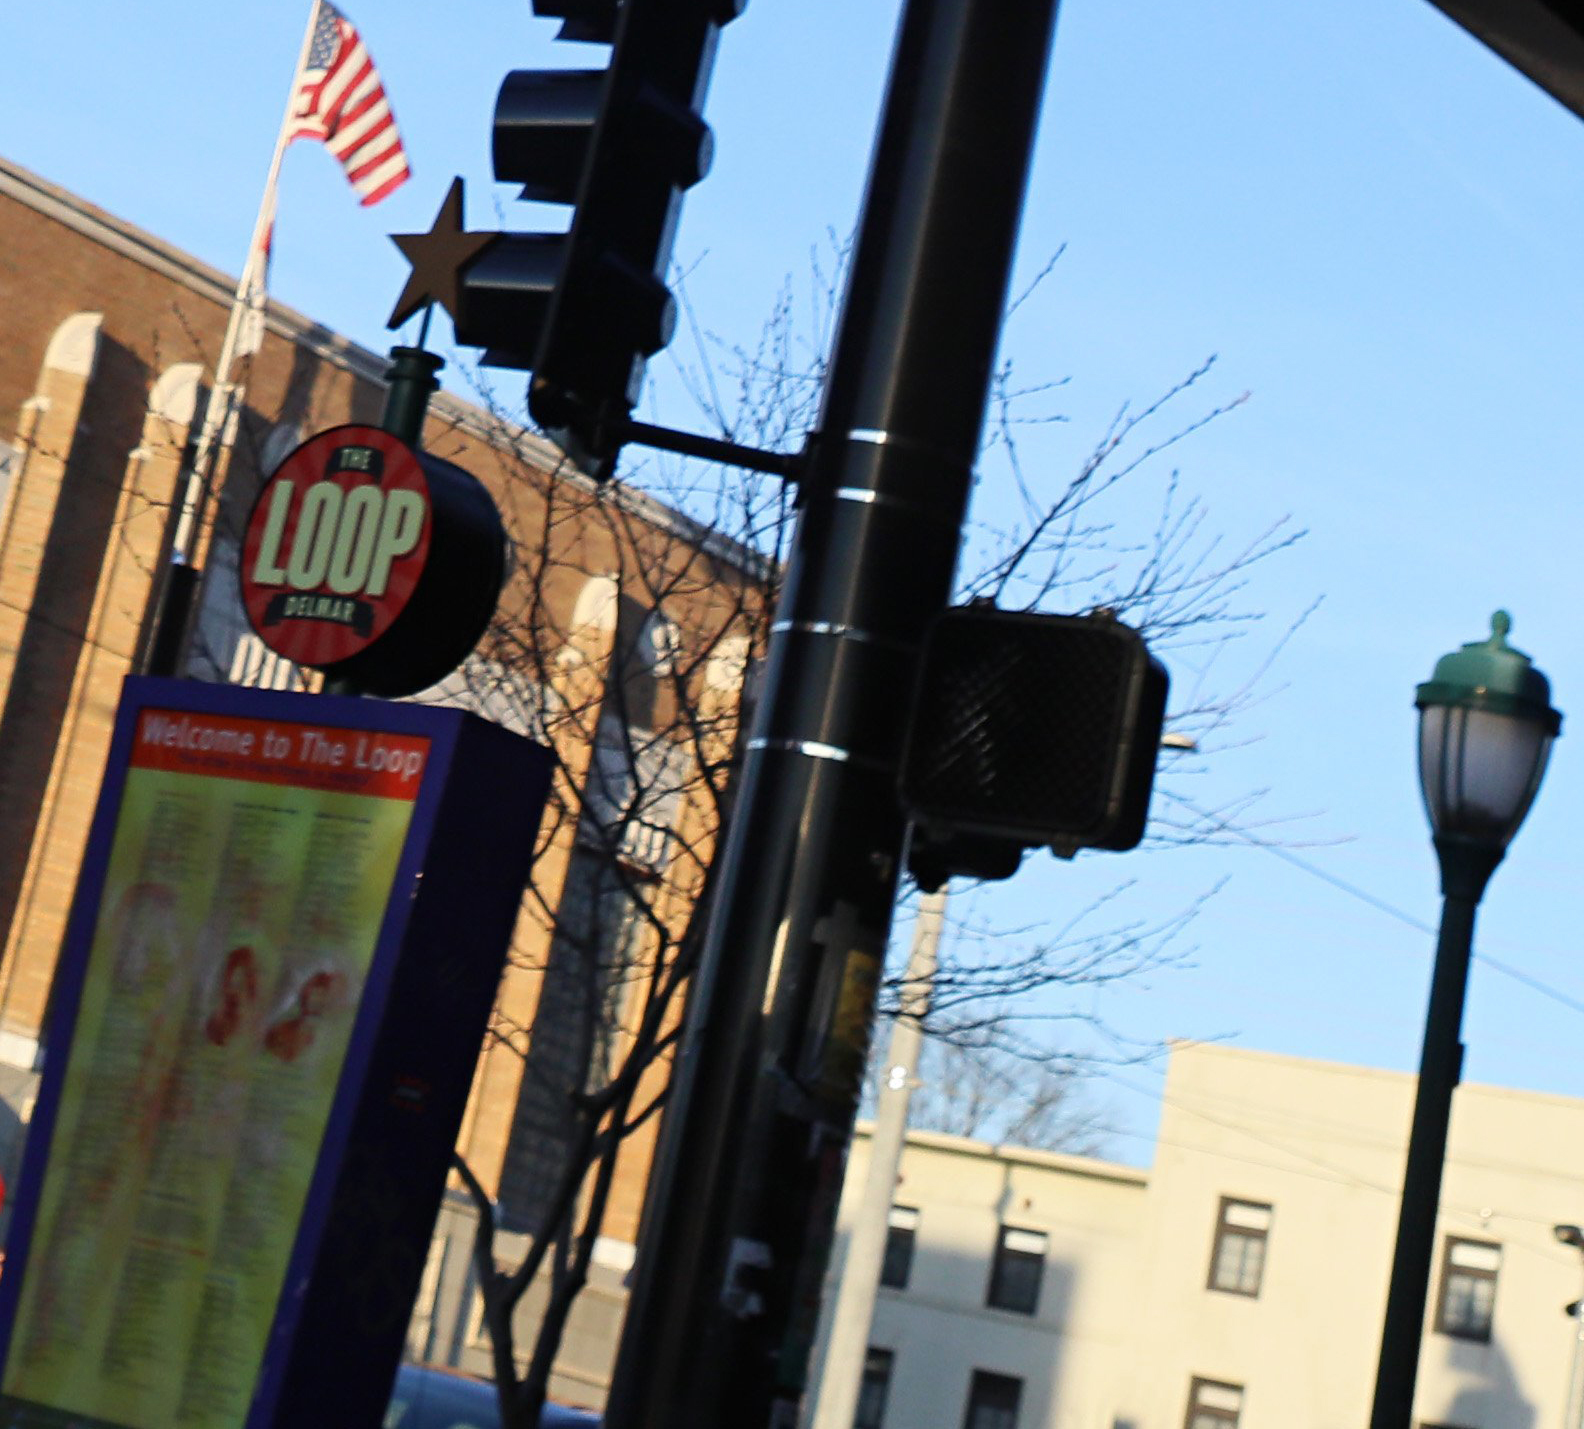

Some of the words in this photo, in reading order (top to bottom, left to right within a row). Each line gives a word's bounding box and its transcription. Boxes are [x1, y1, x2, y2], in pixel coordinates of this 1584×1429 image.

[340, 446, 374, 470] THE
[252, 479, 426, 597] LOOP
[283, 596, 356, 623] DELMAR
[141, 713, 256, 756] Welcome
[261, 729, 291, 759] to
[299, 729, 347, 766] The
[354, 737, 424, 783] Loop
